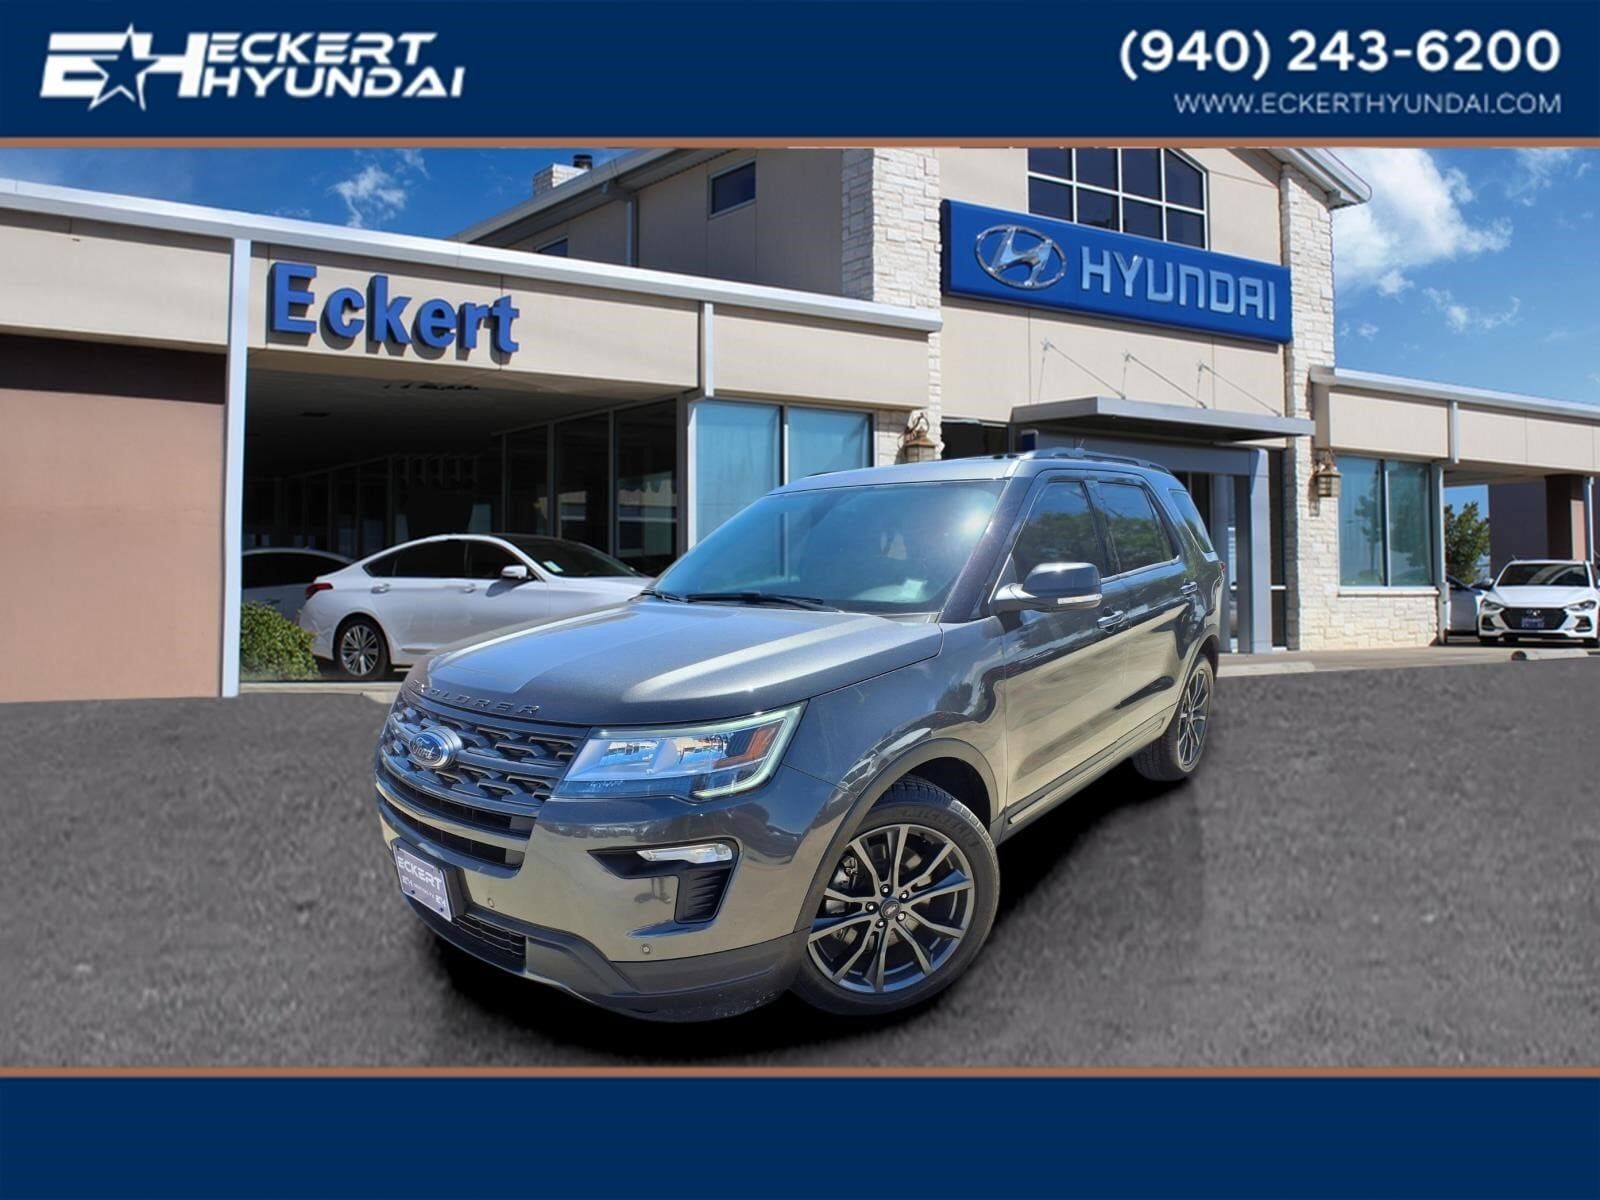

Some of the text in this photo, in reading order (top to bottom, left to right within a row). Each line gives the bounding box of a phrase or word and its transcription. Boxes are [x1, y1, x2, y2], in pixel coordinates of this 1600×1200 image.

[268, 261, 520, 354] Eckert
[1081, 245, 1276, 322] HYUNDAI
[397, 855, 443, 890] ECKERT
